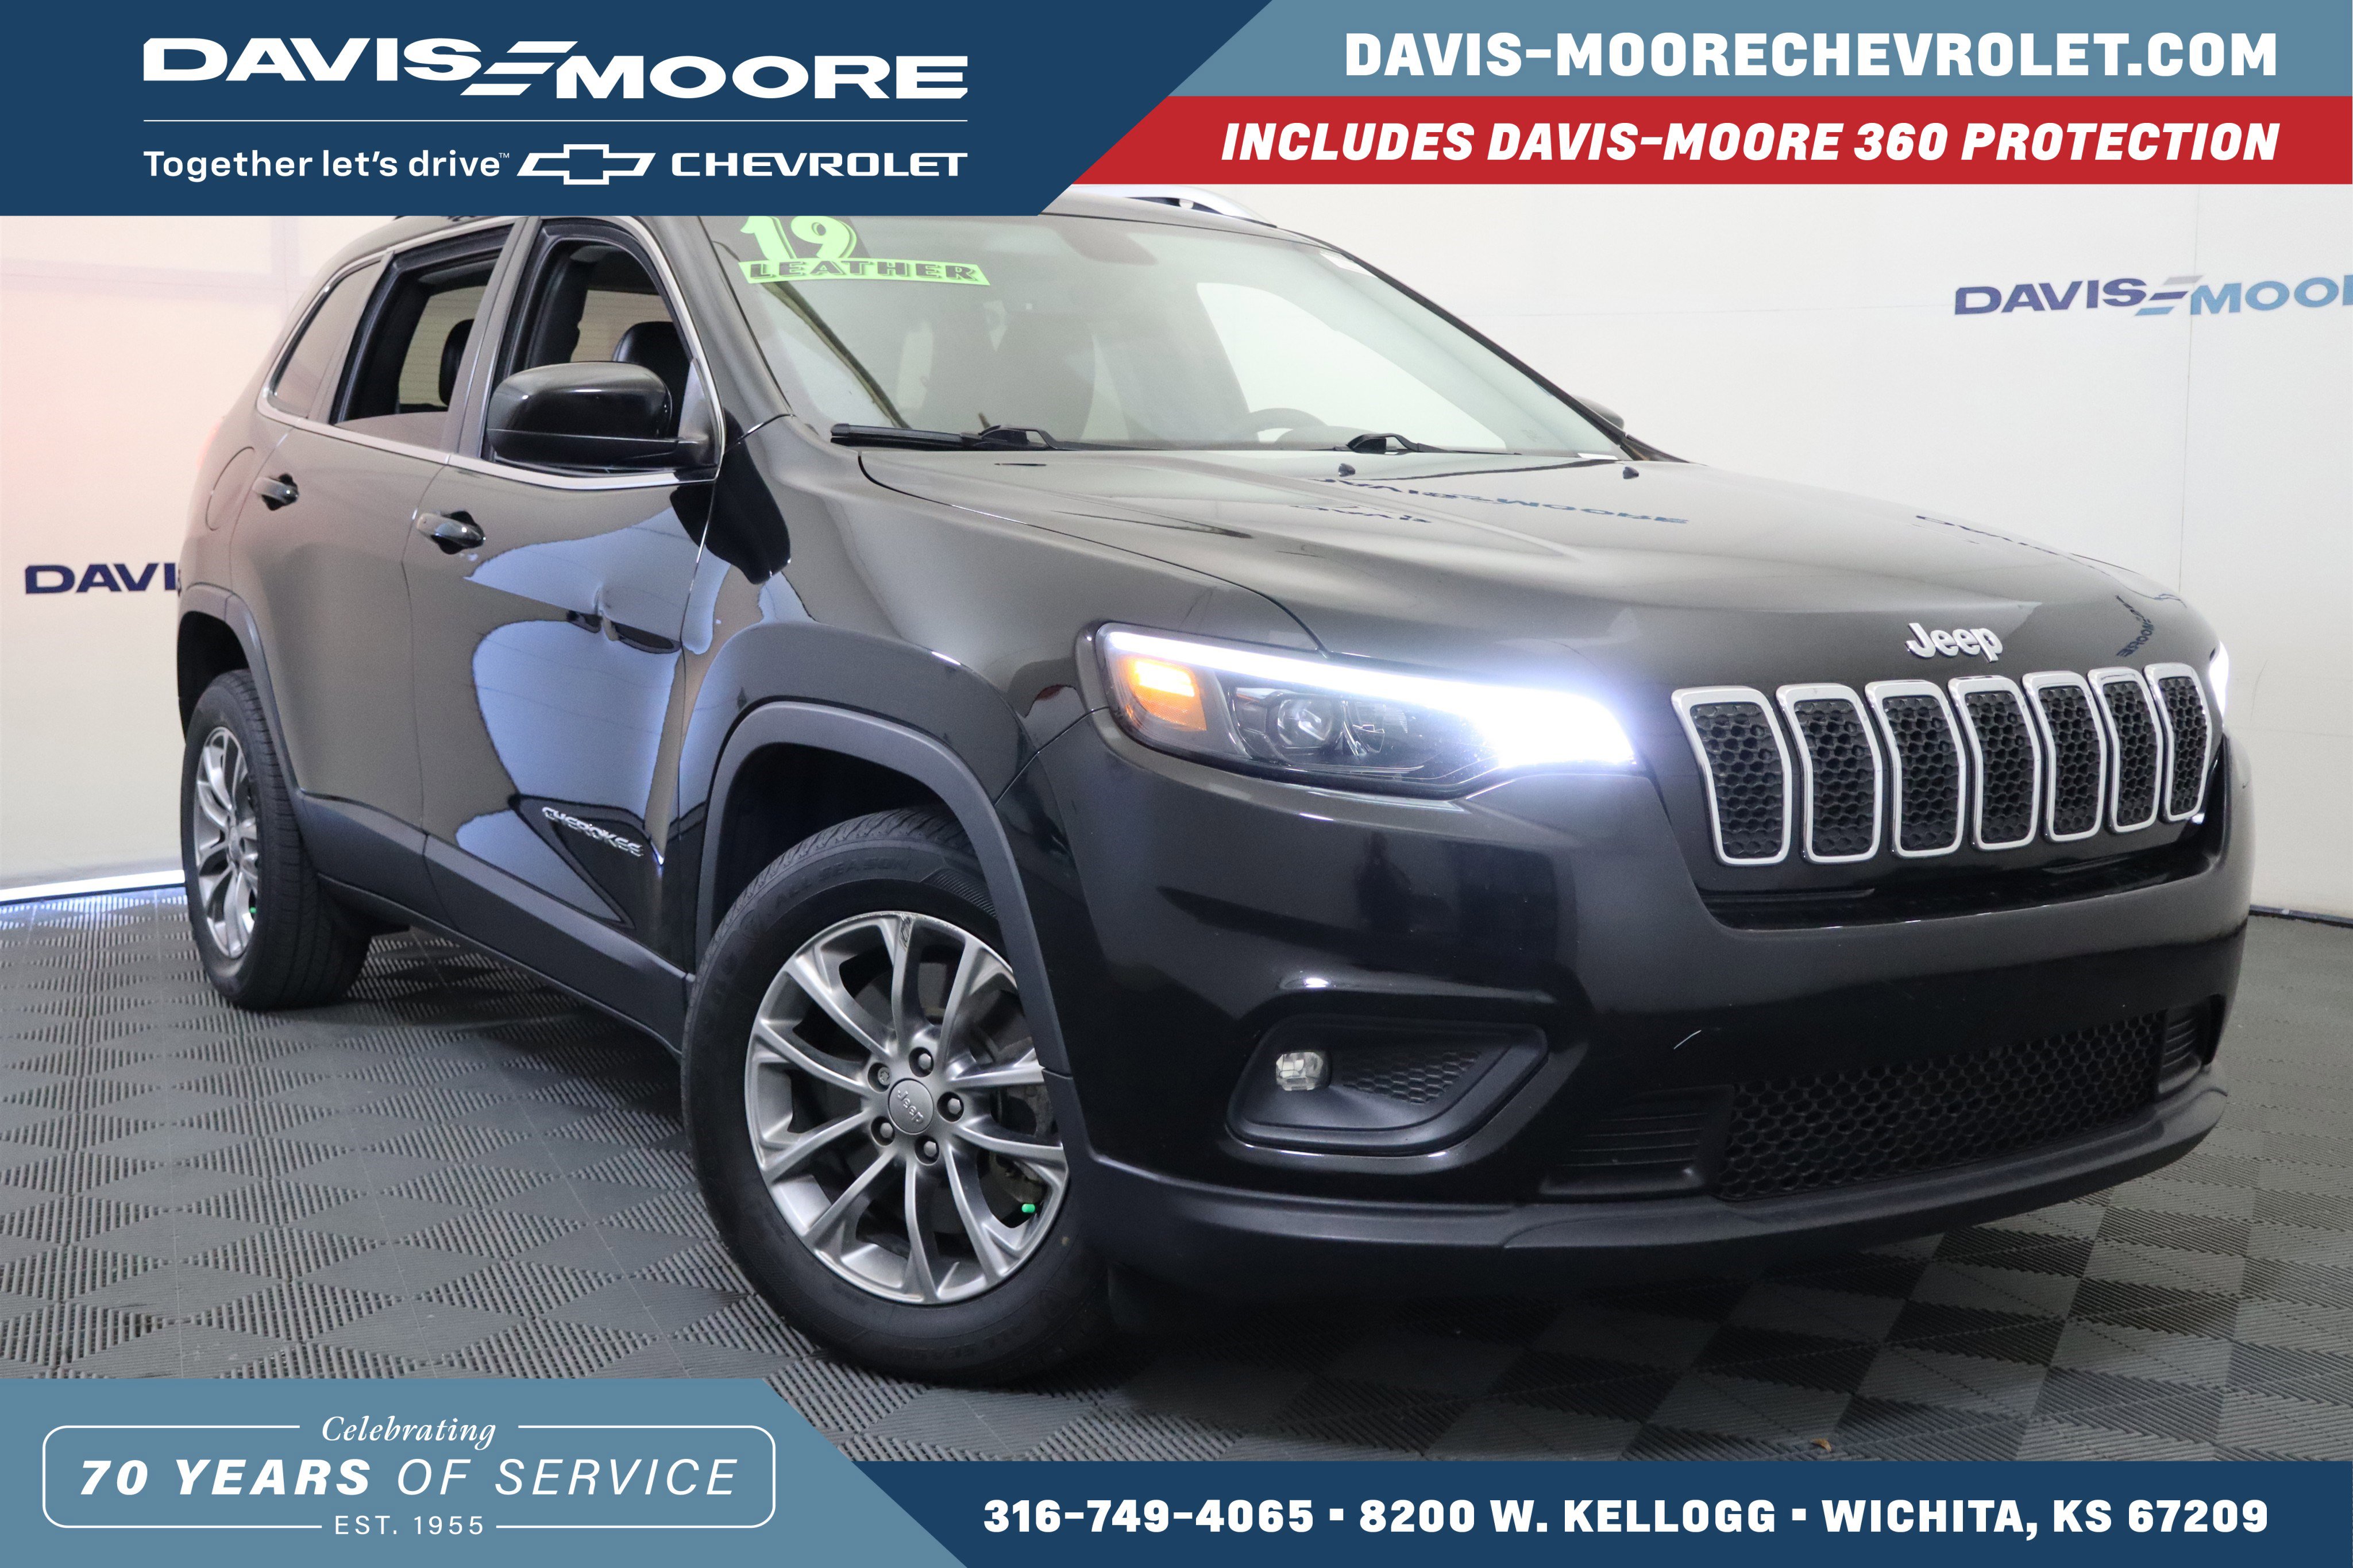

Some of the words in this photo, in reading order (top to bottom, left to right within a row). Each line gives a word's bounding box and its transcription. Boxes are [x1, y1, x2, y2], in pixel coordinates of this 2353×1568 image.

[740, 216, 857, 259] 19
[750, 260, 978, 282] LEATHER
[1954, 277, 2147, 315] DAVIS
[2190, 274, 2353, 315] MOO
[25, 562, 176, 594] DAVI
[1905, 623, 2003, 663] Jeep
[542, 806, 644, 857] CHEROKEE
[897, 1089, 924, 1124] Jeep
